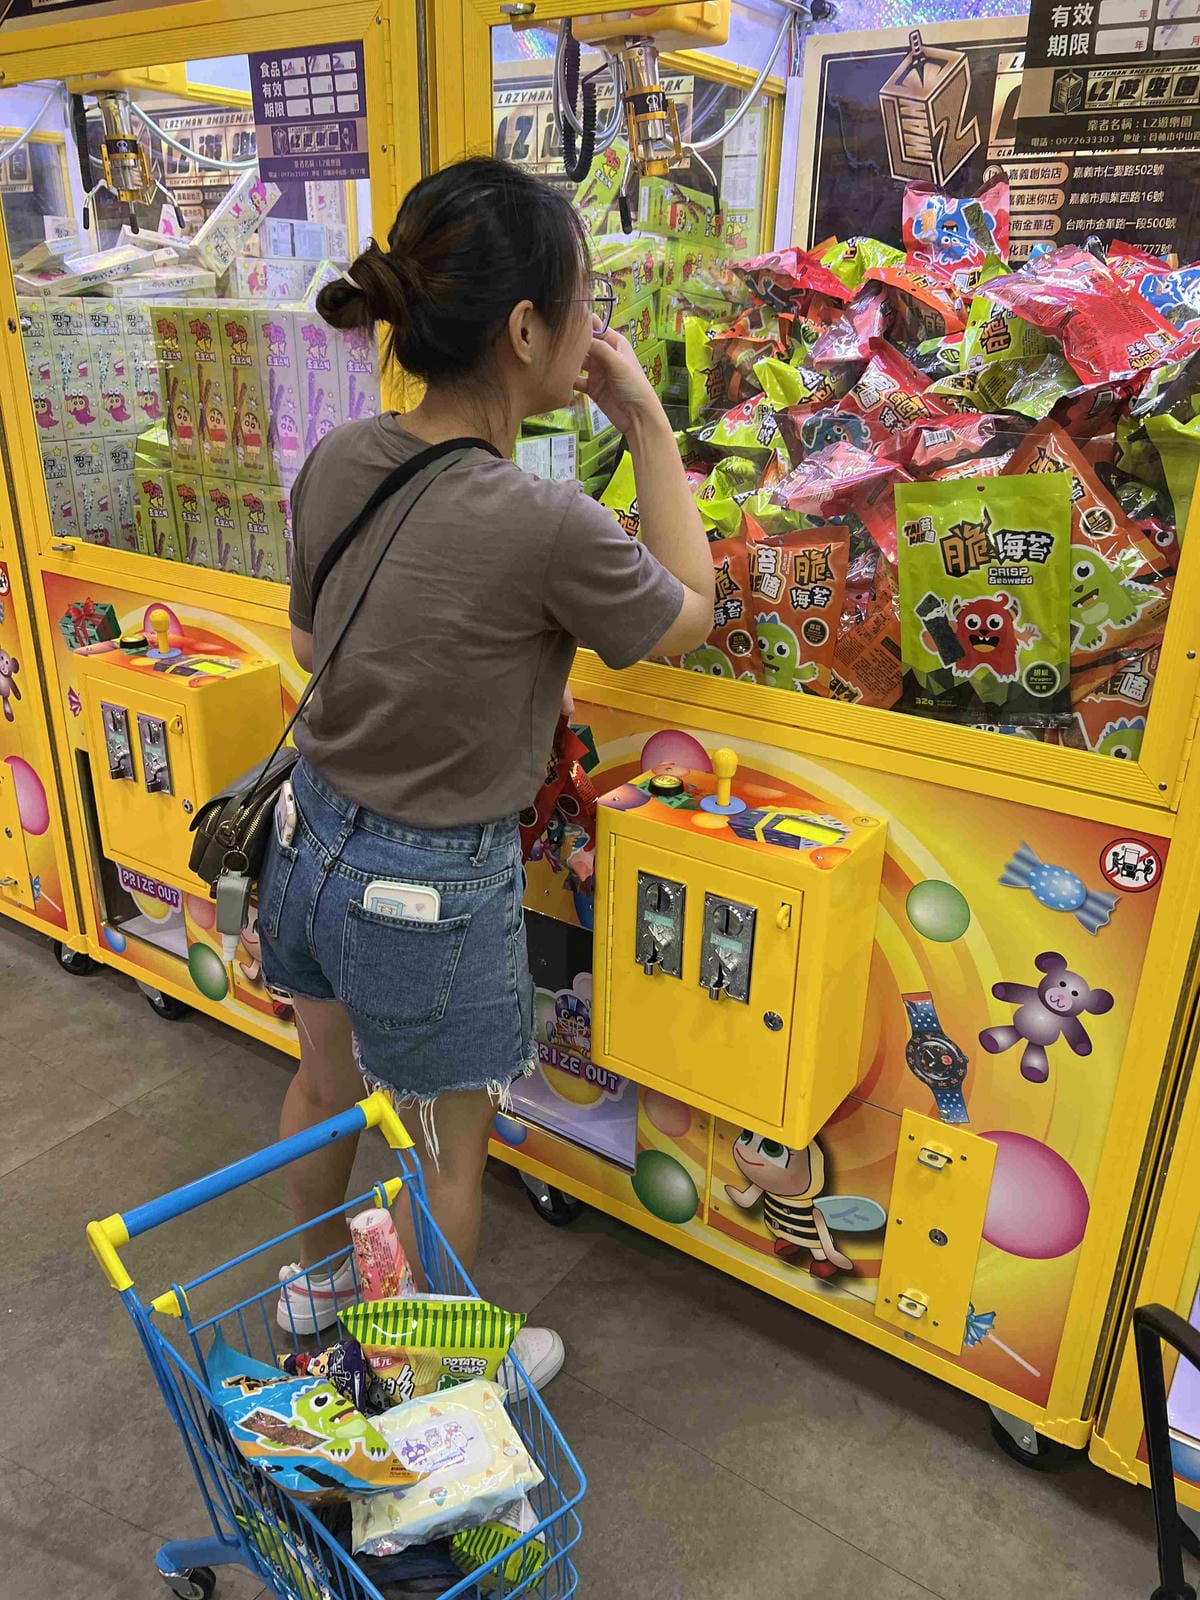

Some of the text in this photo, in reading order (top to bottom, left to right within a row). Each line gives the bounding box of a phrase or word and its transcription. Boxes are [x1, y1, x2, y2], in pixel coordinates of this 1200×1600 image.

[1051, 3, 1095, 29] 有效
[1047, 33, 1091, 58] 期限
[260, 61, 281, 79] 食品
[262, 82, 283, 98] 有效
[264, 101, 285, 118] 期限
[1008, 218, 1055, 232] 南金華店
[988, 567, 1030, 578] CRISP
[988, 576, 1034, 586] Seaweed
[122, 869, 178, 905] PRIZE OUT
[535, 1042, 618, 1091] RIZE OUT
[443, 1357, 487, 1367] POTATO
[449, 1364, 486, 1376] CHIPS
